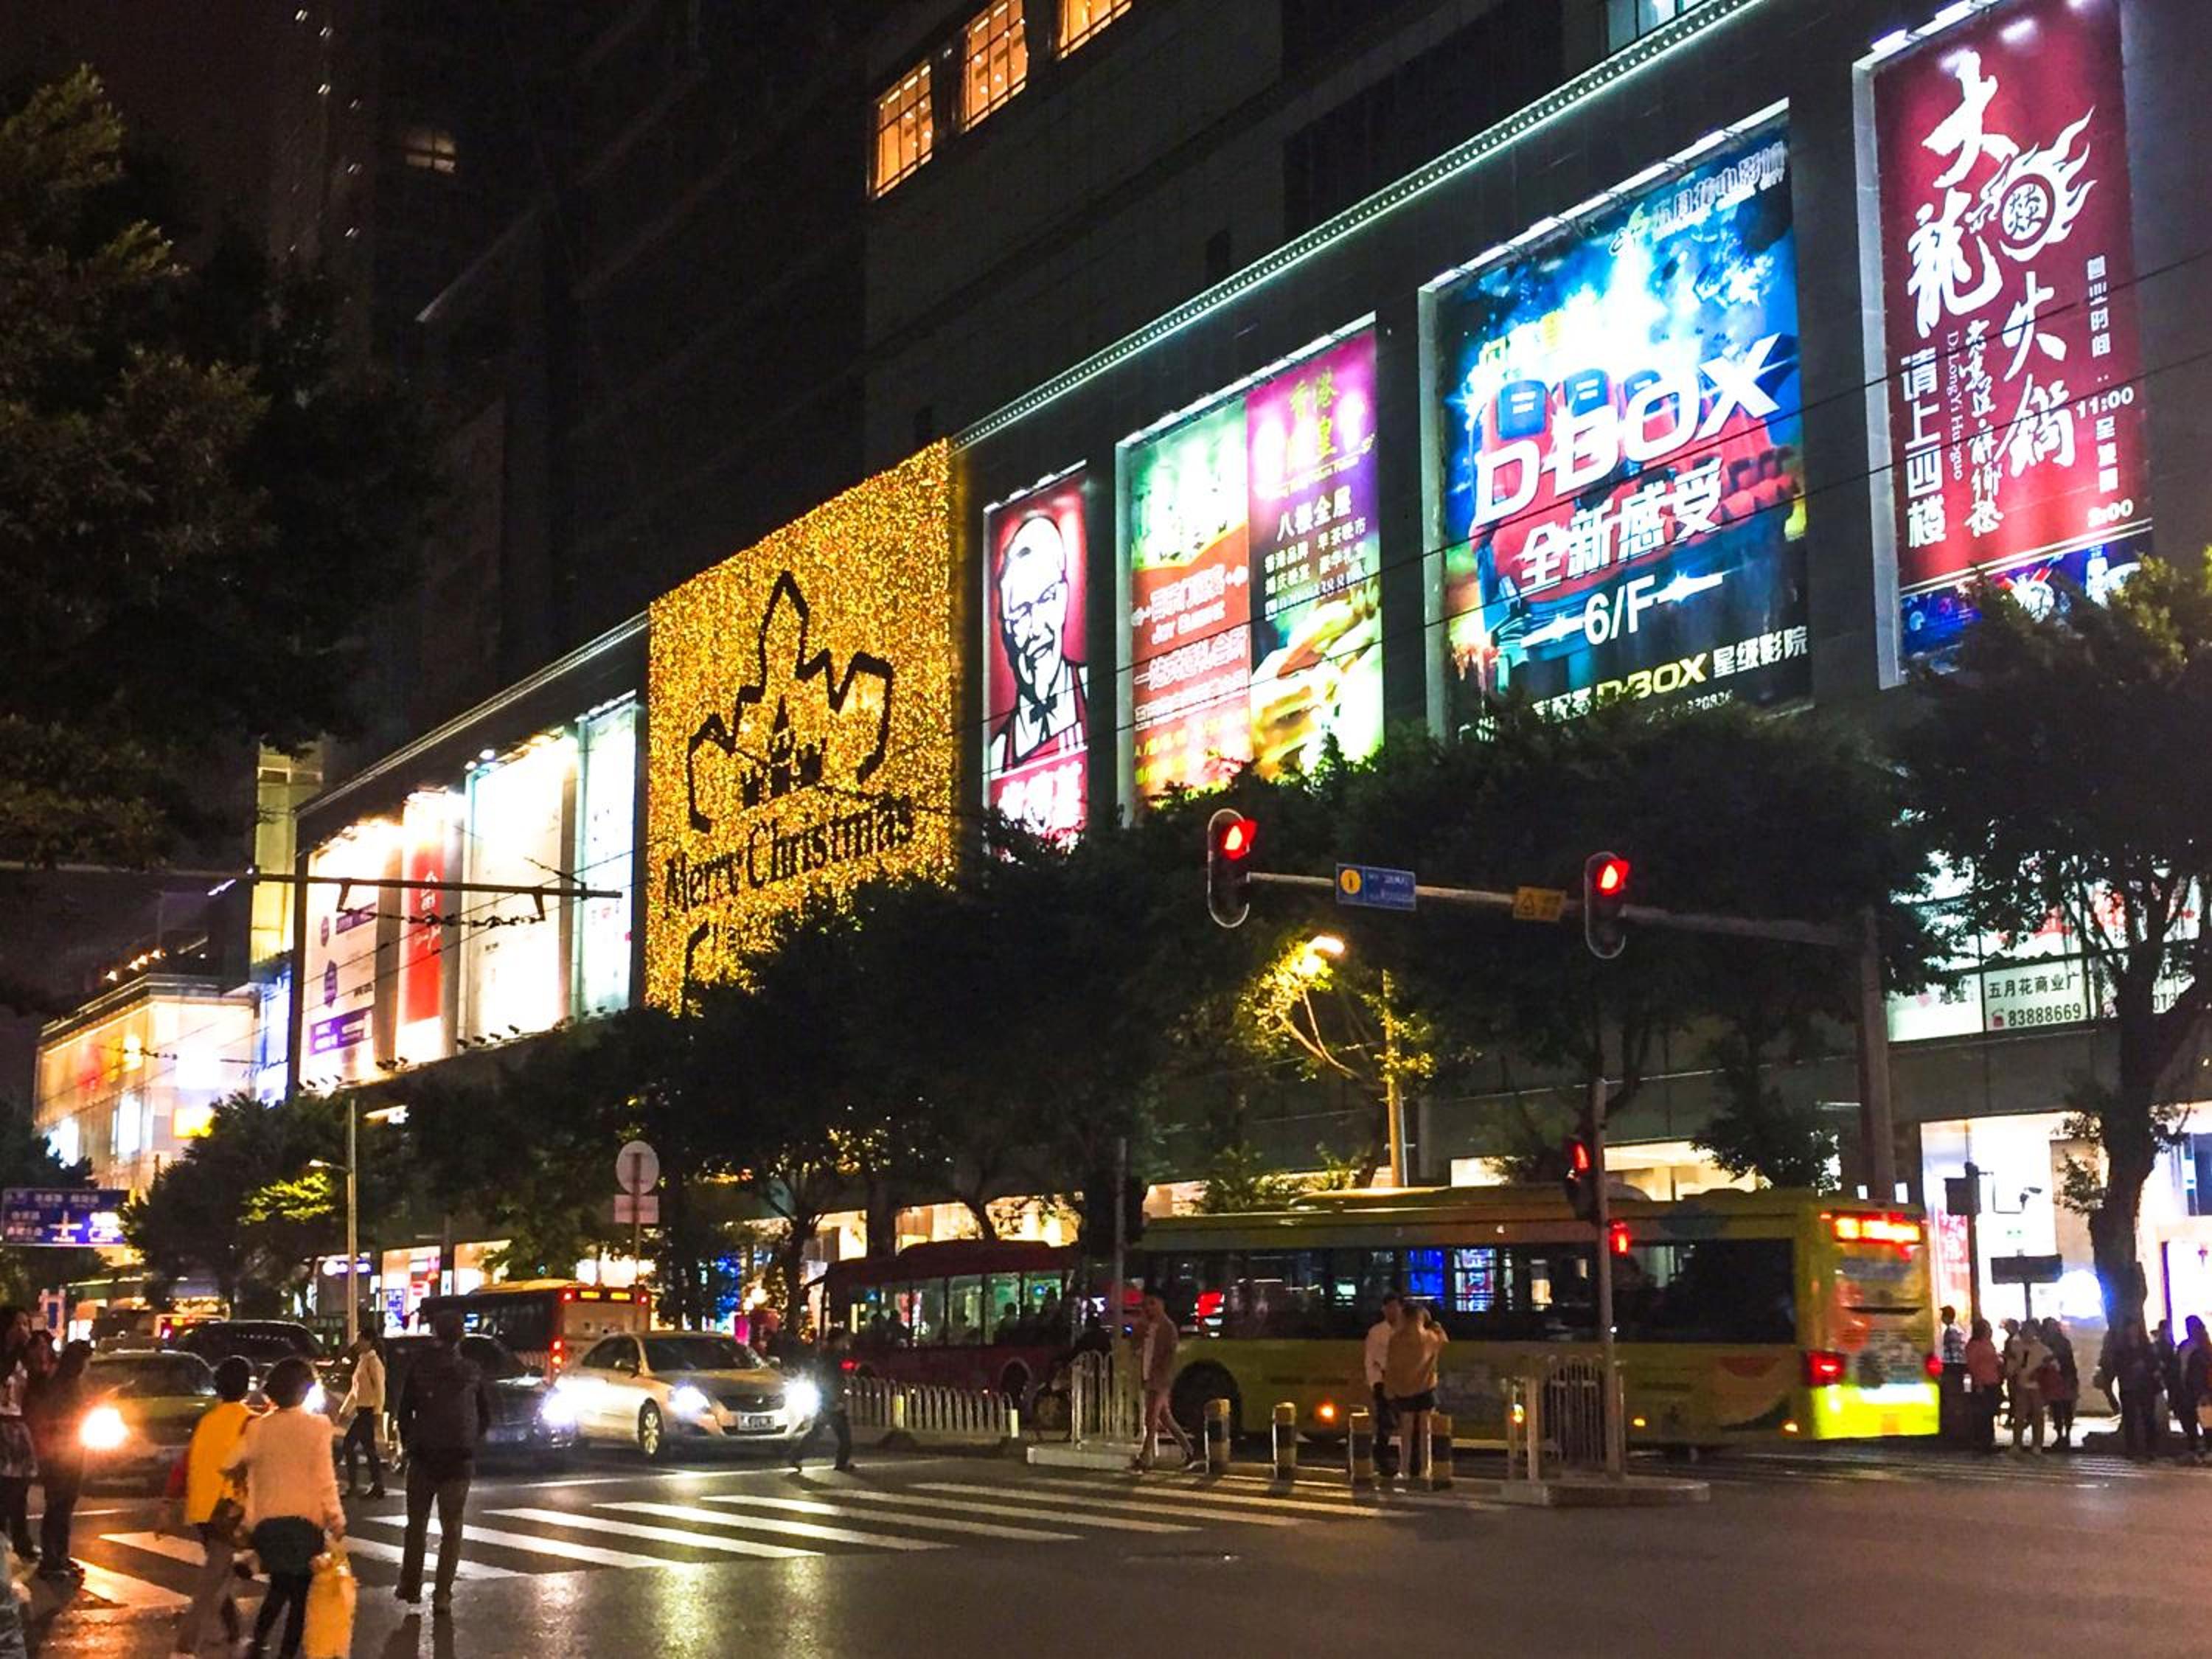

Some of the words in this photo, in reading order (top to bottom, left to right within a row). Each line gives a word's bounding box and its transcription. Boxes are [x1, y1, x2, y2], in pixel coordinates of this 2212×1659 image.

[2076, 386, 2134, 419] 11:00
[1900, 347, 1947, 547] 请上四楼
[1520, 458, 1722, 593] 全新感受
[1583, 574, 1656, 645] 6/F
[1596, 653, 1708, 712] D-BOX
[1712, 625, 1808, 678] 星级影院
[746, 794, 915, 888] Christmas
[1988, 973, 2081, 1000] 五月花商业广
[2008, 1003, 2082, 1028] 83888669
